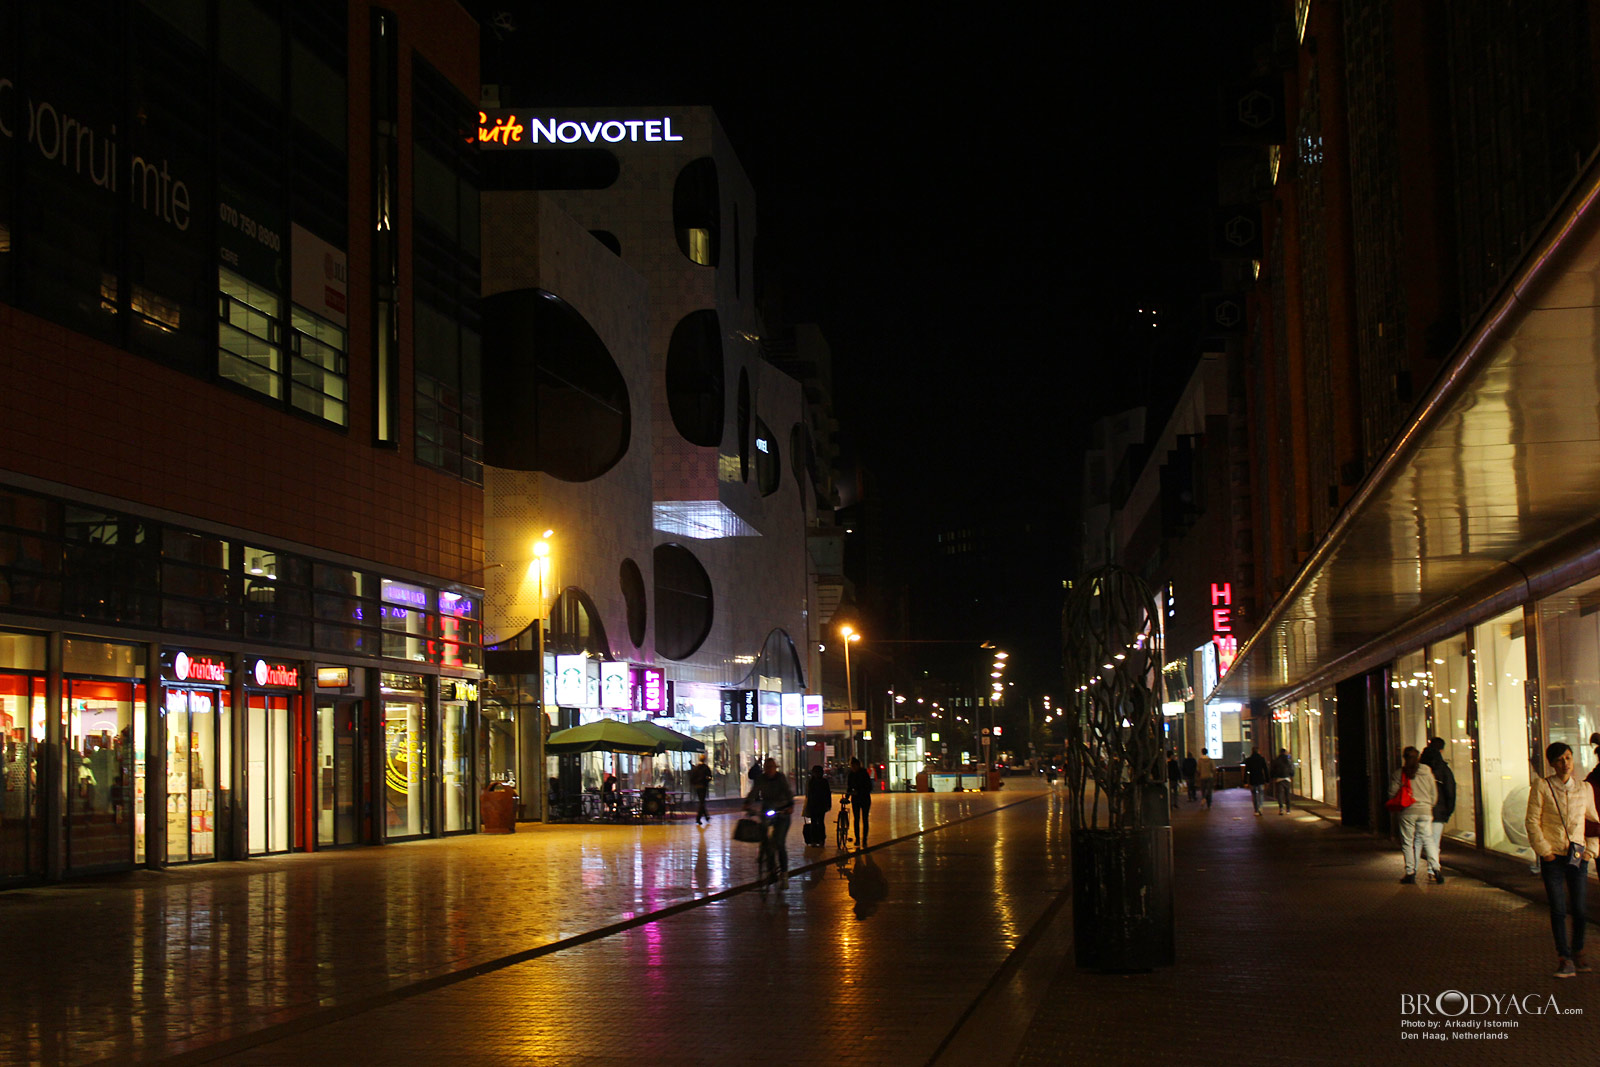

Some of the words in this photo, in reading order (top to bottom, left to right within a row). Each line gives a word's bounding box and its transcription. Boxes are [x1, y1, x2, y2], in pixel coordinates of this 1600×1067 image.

[532, 117, 684, 144] NOVOTEL
[186, 656, 226, 682] Kruidvat
[265, 664, 298, 687] Kruidvat
